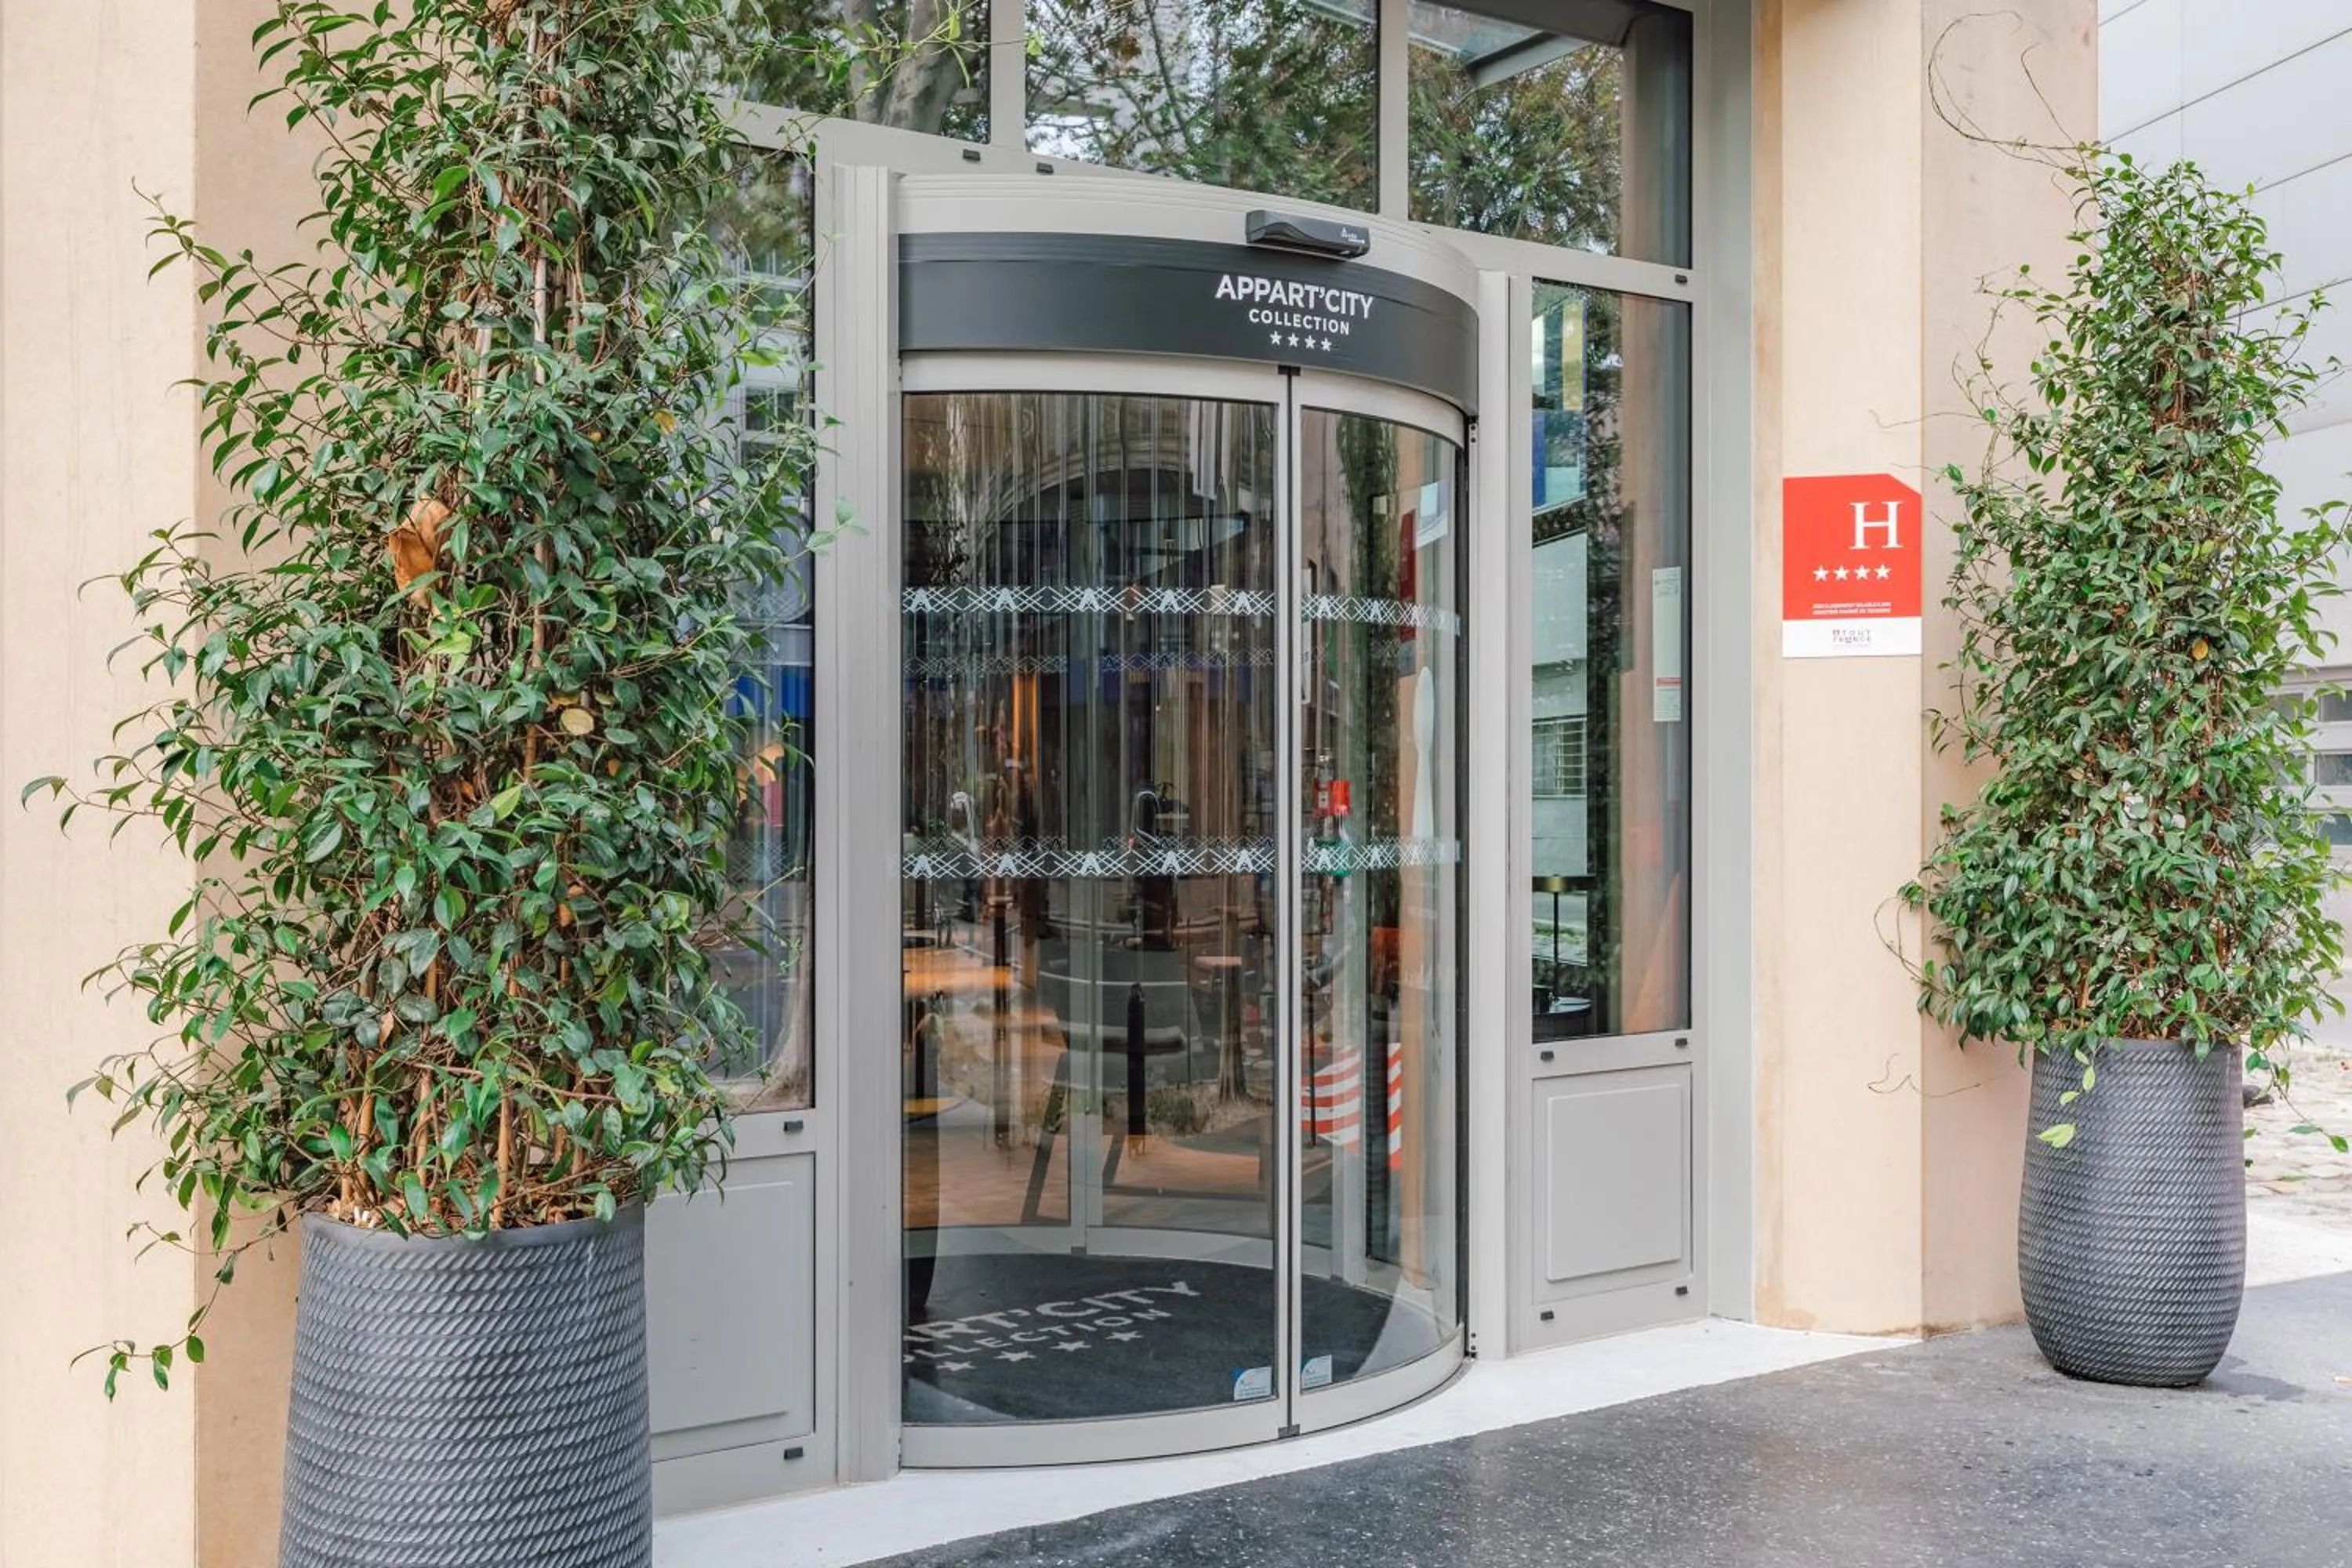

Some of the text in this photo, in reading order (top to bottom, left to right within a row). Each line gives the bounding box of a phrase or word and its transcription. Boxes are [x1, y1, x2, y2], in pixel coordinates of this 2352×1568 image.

[1215, 274, 1374, 318] APPART'CITY
[1249, 308, 1349, 336] COLLECTION
[1849, 500, 1904, 550] H
[910, 588, 933, 612] A
[996, 587, 1018, 611] A
[1079, 588, 1100, 612] A
[1160, 590, 1180, 612] A
[1233, 591, 1253, 614] A
[911, 854, 934, 877] A
[997, 853, 1020, 877] A
[1081, 852, 1102, 876] A
[1161, 850, 1182, 875] A
[1236, 849, 1255, 874] A
